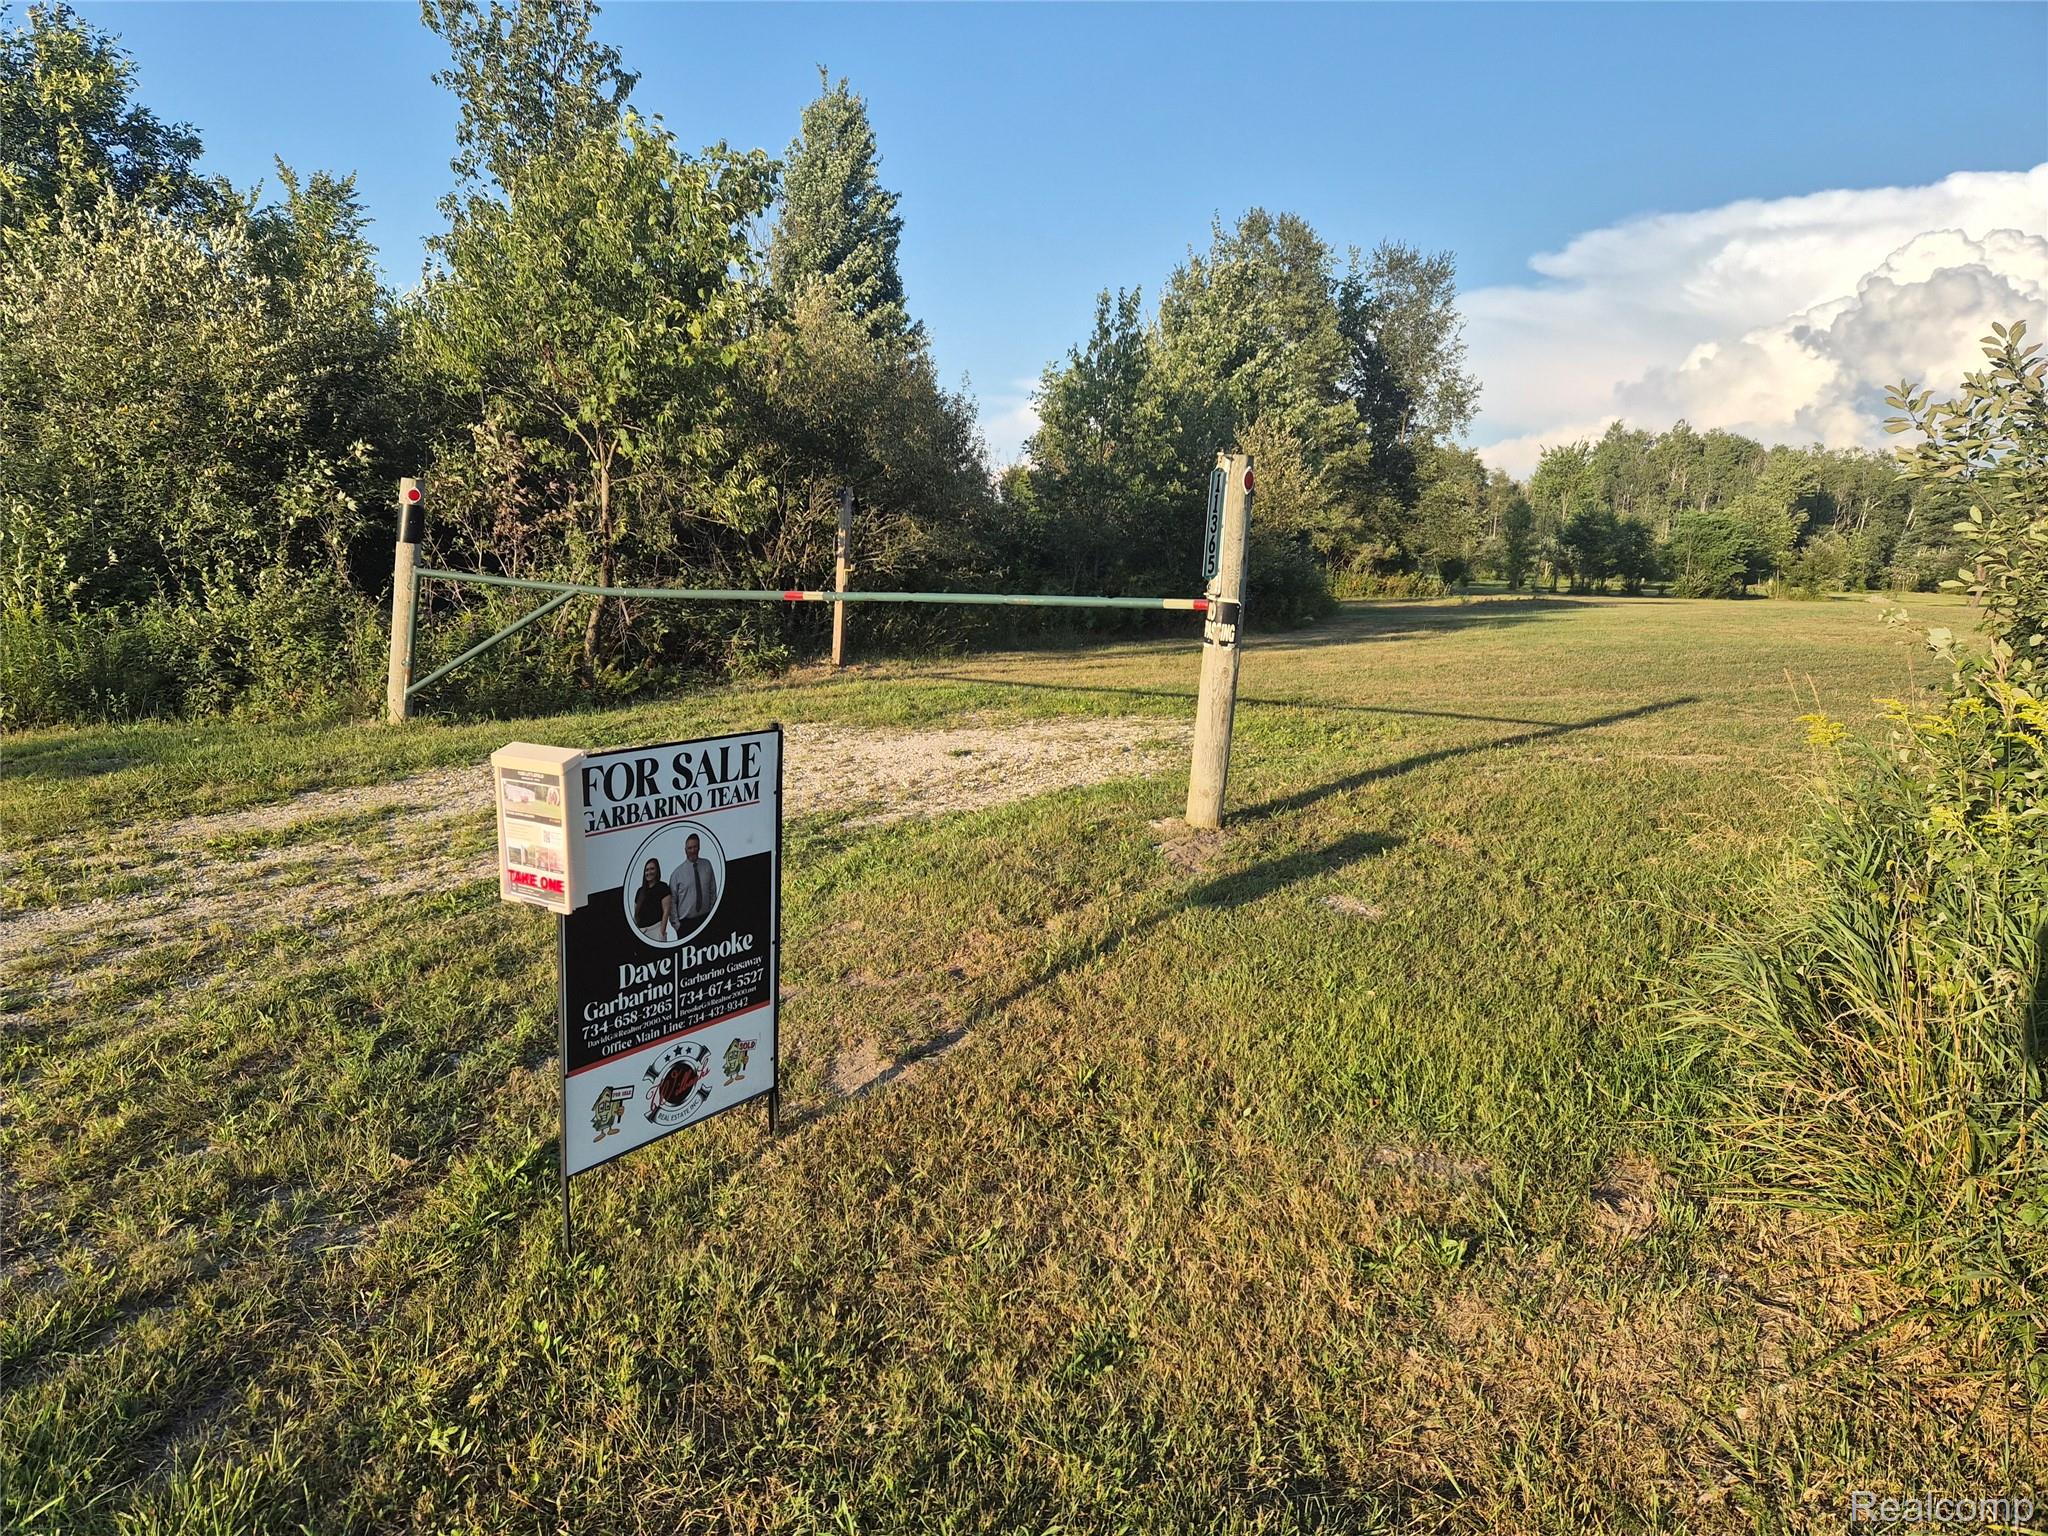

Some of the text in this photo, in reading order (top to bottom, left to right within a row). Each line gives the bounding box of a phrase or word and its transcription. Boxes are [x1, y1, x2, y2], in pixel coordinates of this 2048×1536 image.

[1207, 473, 1221, 574] 11365
[582, 742, 762, 807] FOR SALE
[584, 780, 760, 833] GARBARINO TEAM
[507, 869, 538, 888] TAKE
[540, 876, 565, 893] ONE
[682, 931, 754, 971] Brooke
[619, 958, 672, 989] Dave
[679, 967, 764, 1007] 734-674-5527
[680, 955, 763, 988] Garbarino Gasaway
[581, 999, 673, 1040] 734-658-3265
[583, 981, 674, 1022] Garbarino
[601, 997, 749, 1056] Office Main Line: 734-432-9342
[657, 1112, 670, 1122] REAL
[671, 1108, 690, 1121] ESTATE
